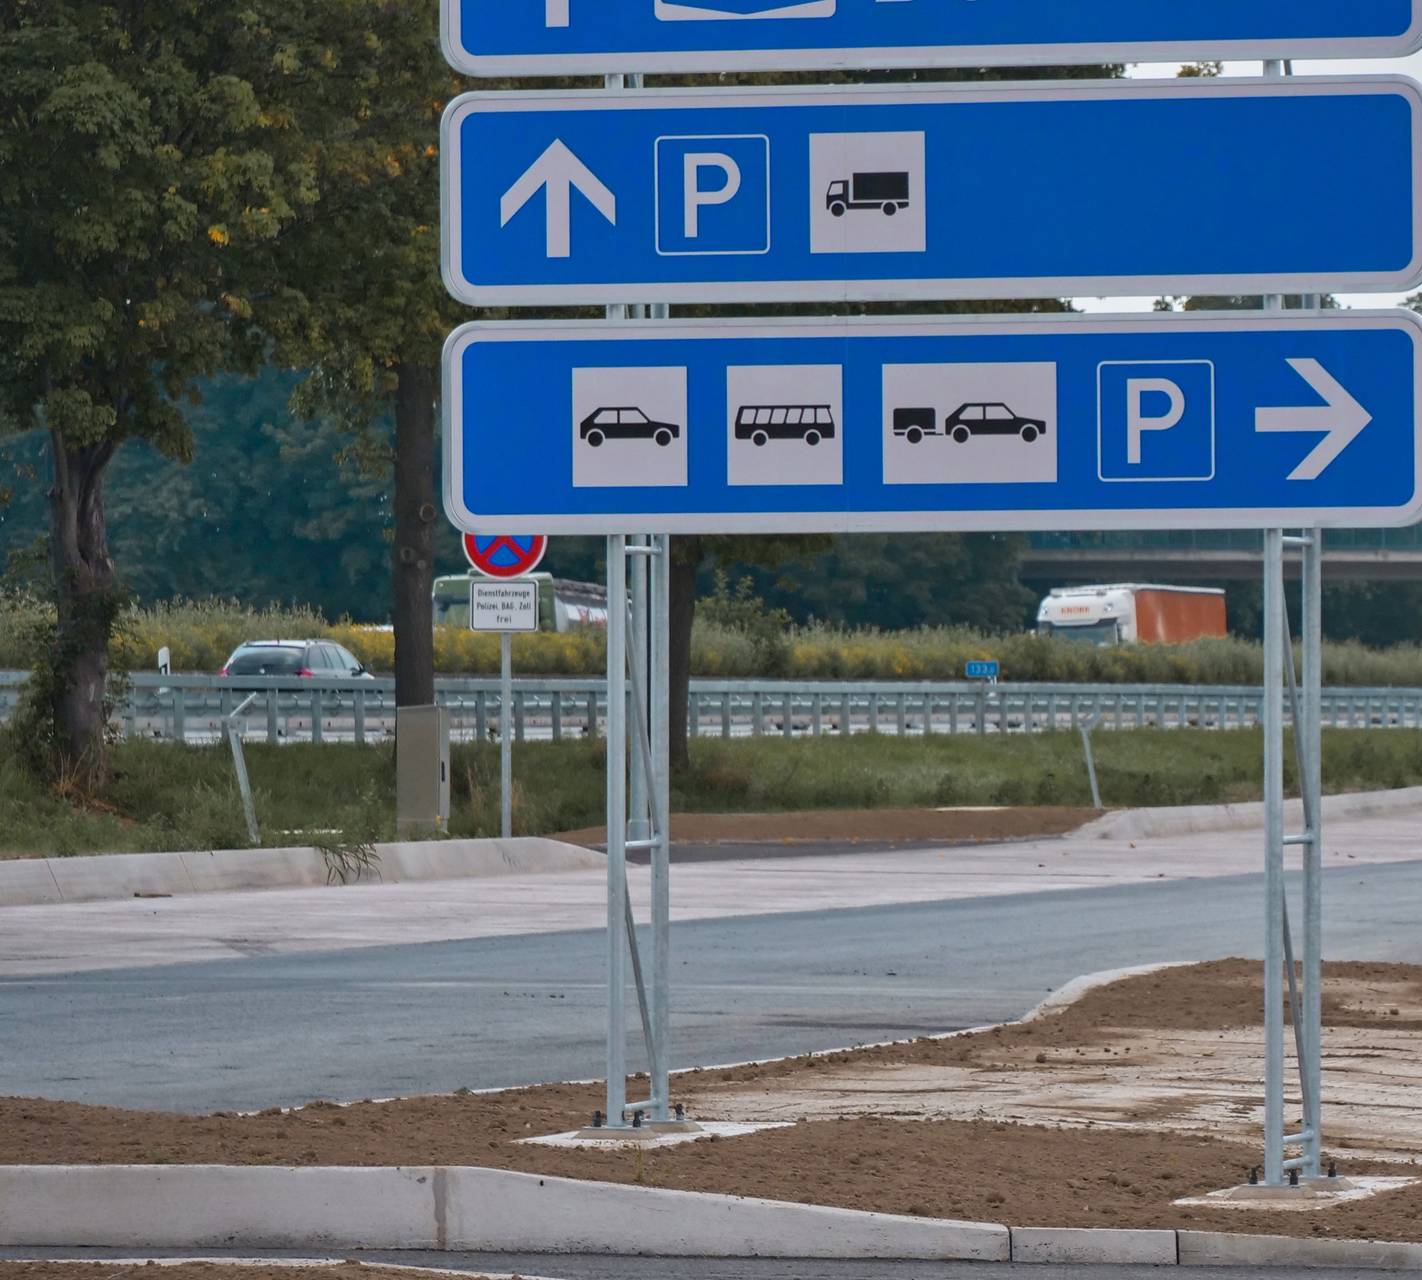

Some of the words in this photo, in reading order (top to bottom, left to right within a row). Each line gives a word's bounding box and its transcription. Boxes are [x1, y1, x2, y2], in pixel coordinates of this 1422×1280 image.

[684, 152, 741, 238] P
[1127, 378, 1185, 464] P
[477, 589, 530, 599] Dienstfahrzeuge
[519, 601, 532, 611] Zoll
[496, 614, 512, 625] frei
